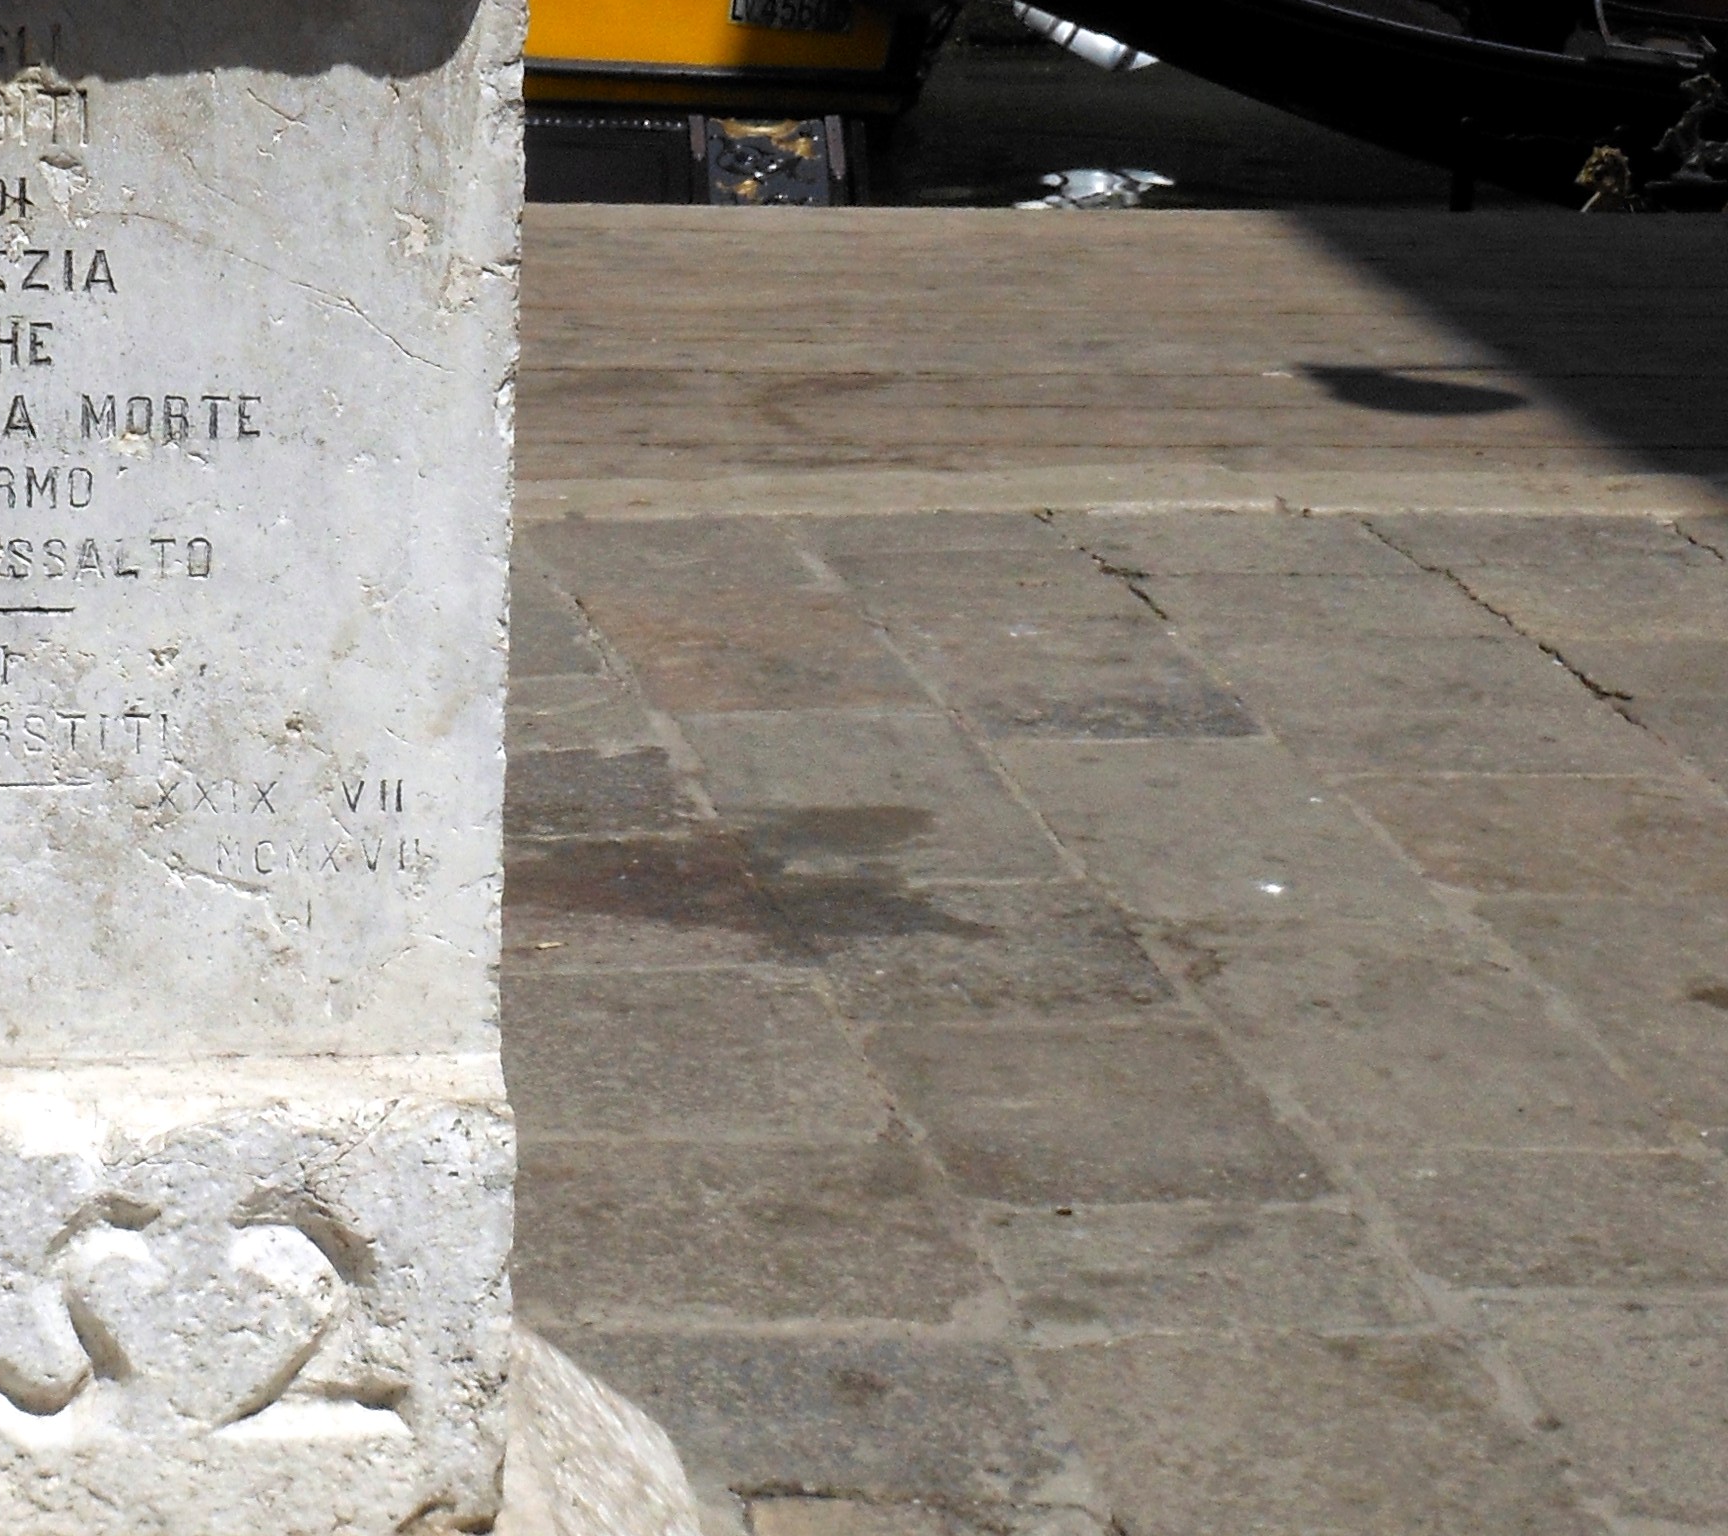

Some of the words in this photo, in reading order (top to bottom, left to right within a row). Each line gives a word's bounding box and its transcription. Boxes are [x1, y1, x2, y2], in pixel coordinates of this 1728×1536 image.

[80, 394, 263, 441] MORTE
[156, 779, 279, 815] XXIX
[340, 778, 405, 814] VII
